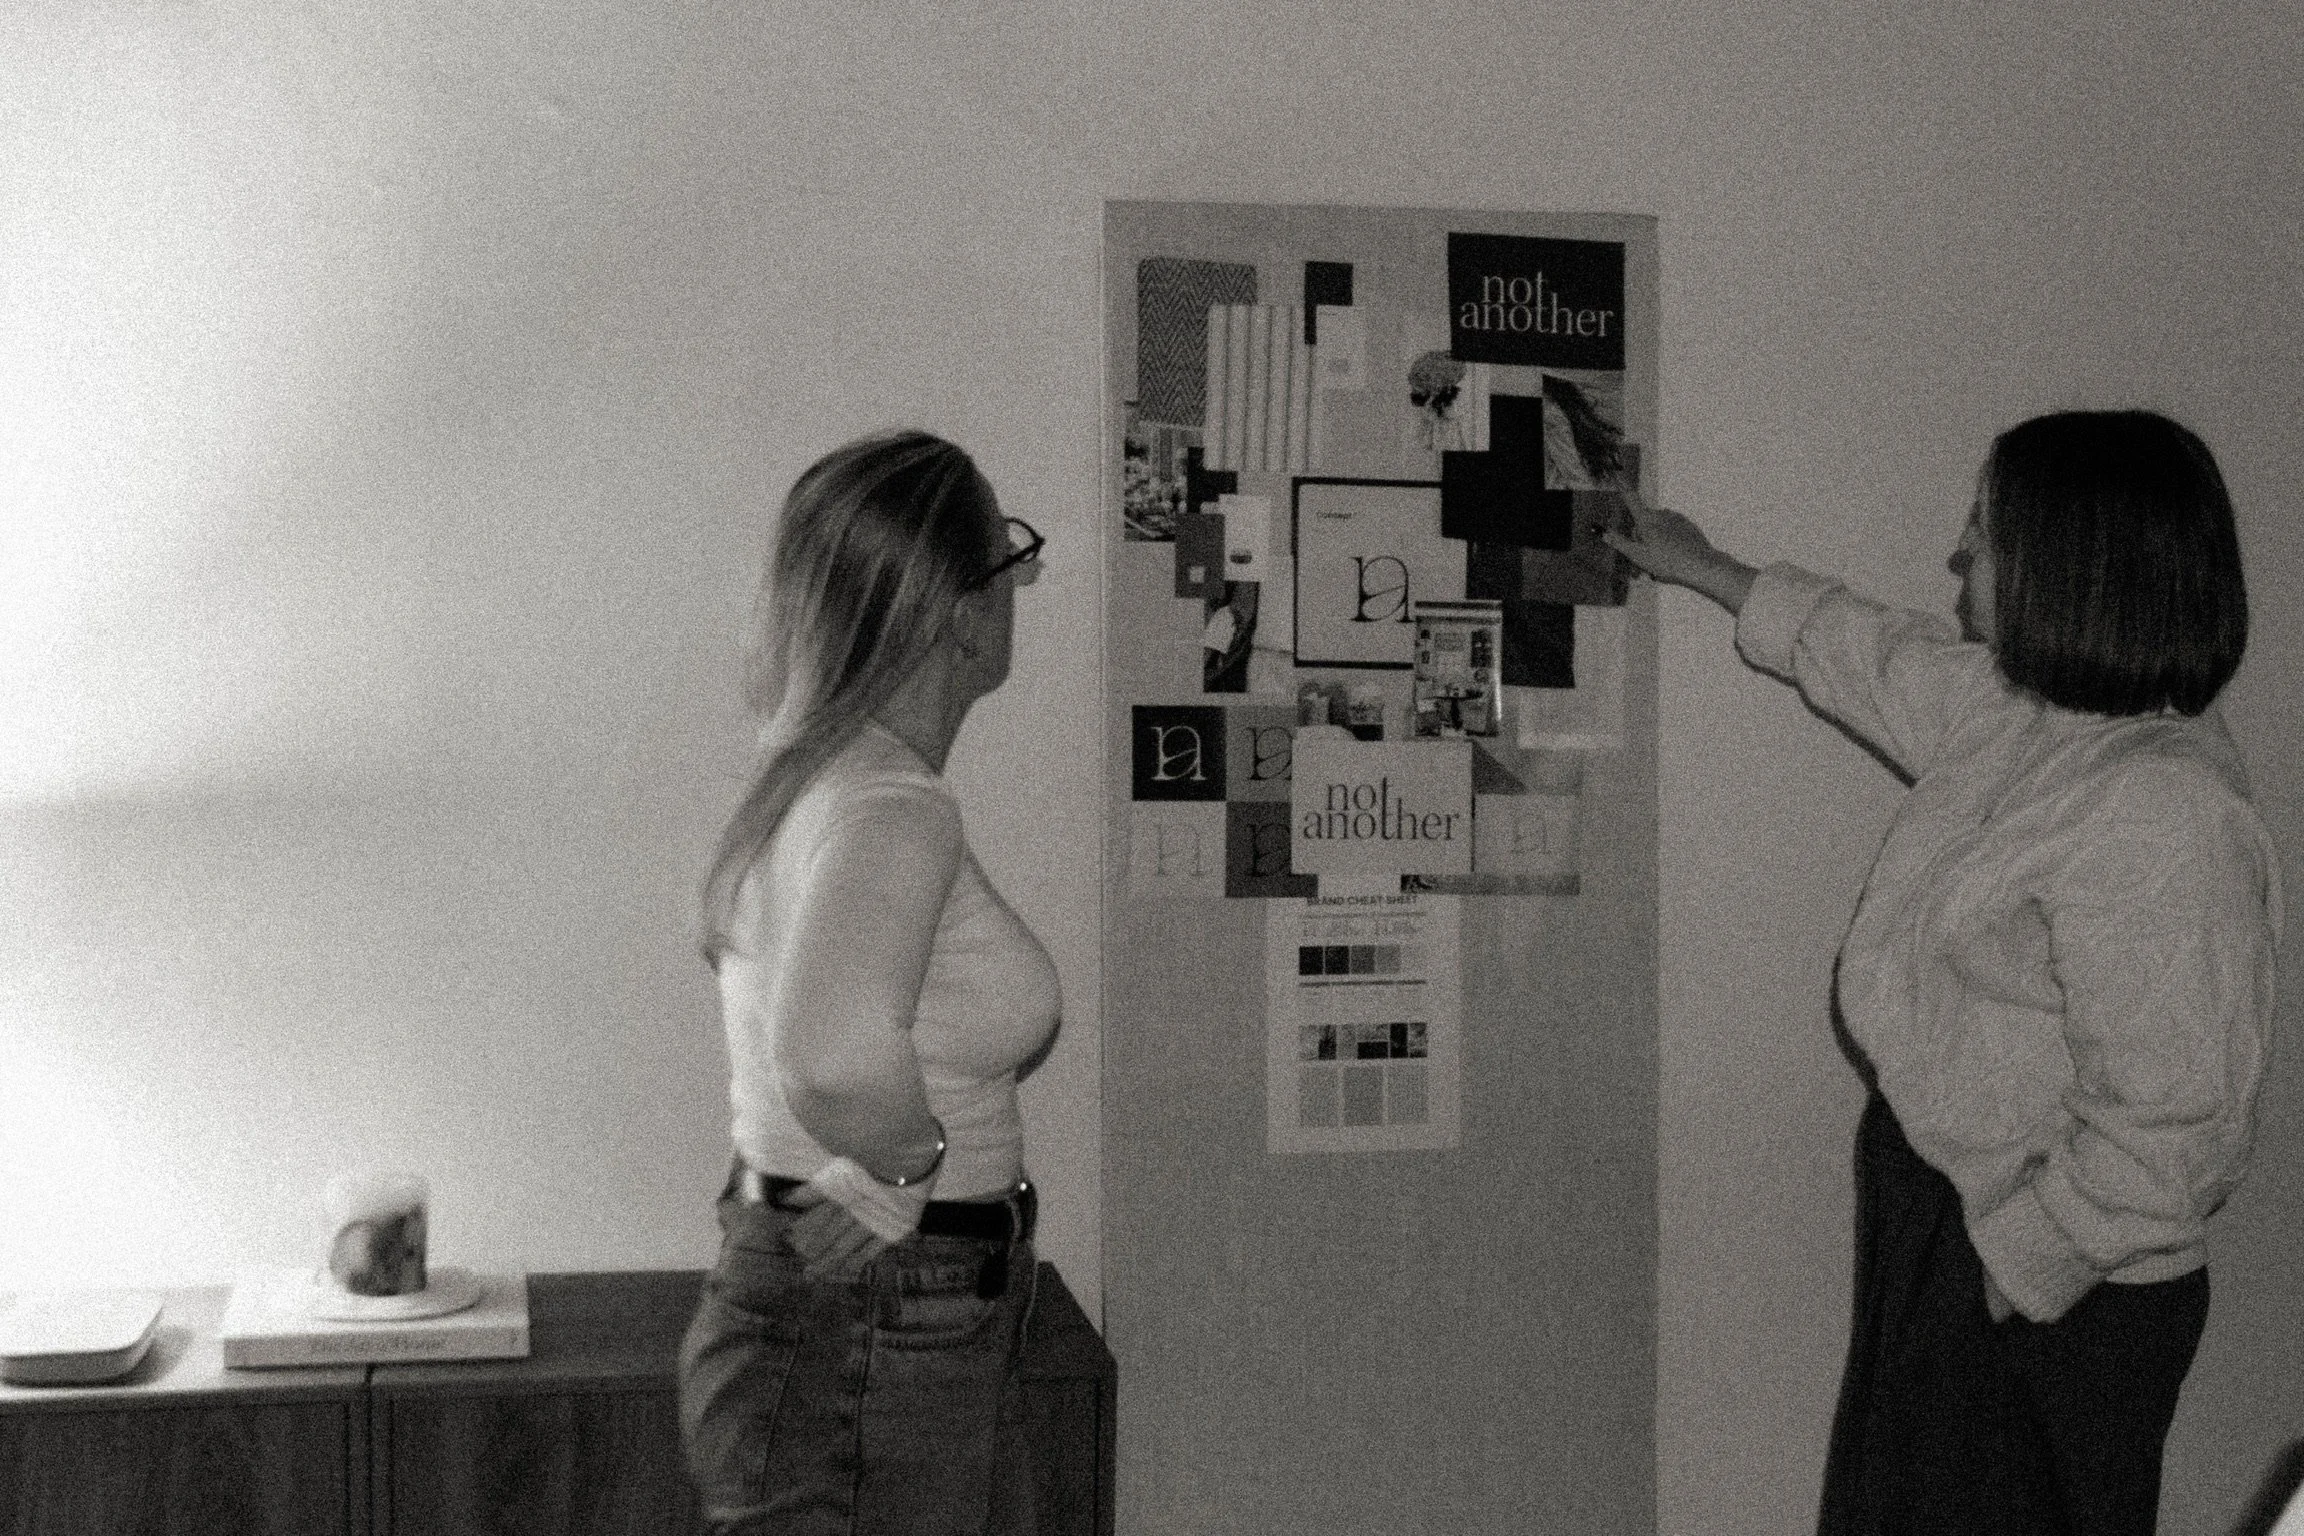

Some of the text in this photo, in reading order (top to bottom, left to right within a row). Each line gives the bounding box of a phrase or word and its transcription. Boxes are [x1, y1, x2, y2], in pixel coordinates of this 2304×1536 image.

[1480, 270, 1549, 304] not
[1460, 292, 1615, 338] another
[1326, 776, 1393, 811] not
[1303, 797, 1460, 841] another
